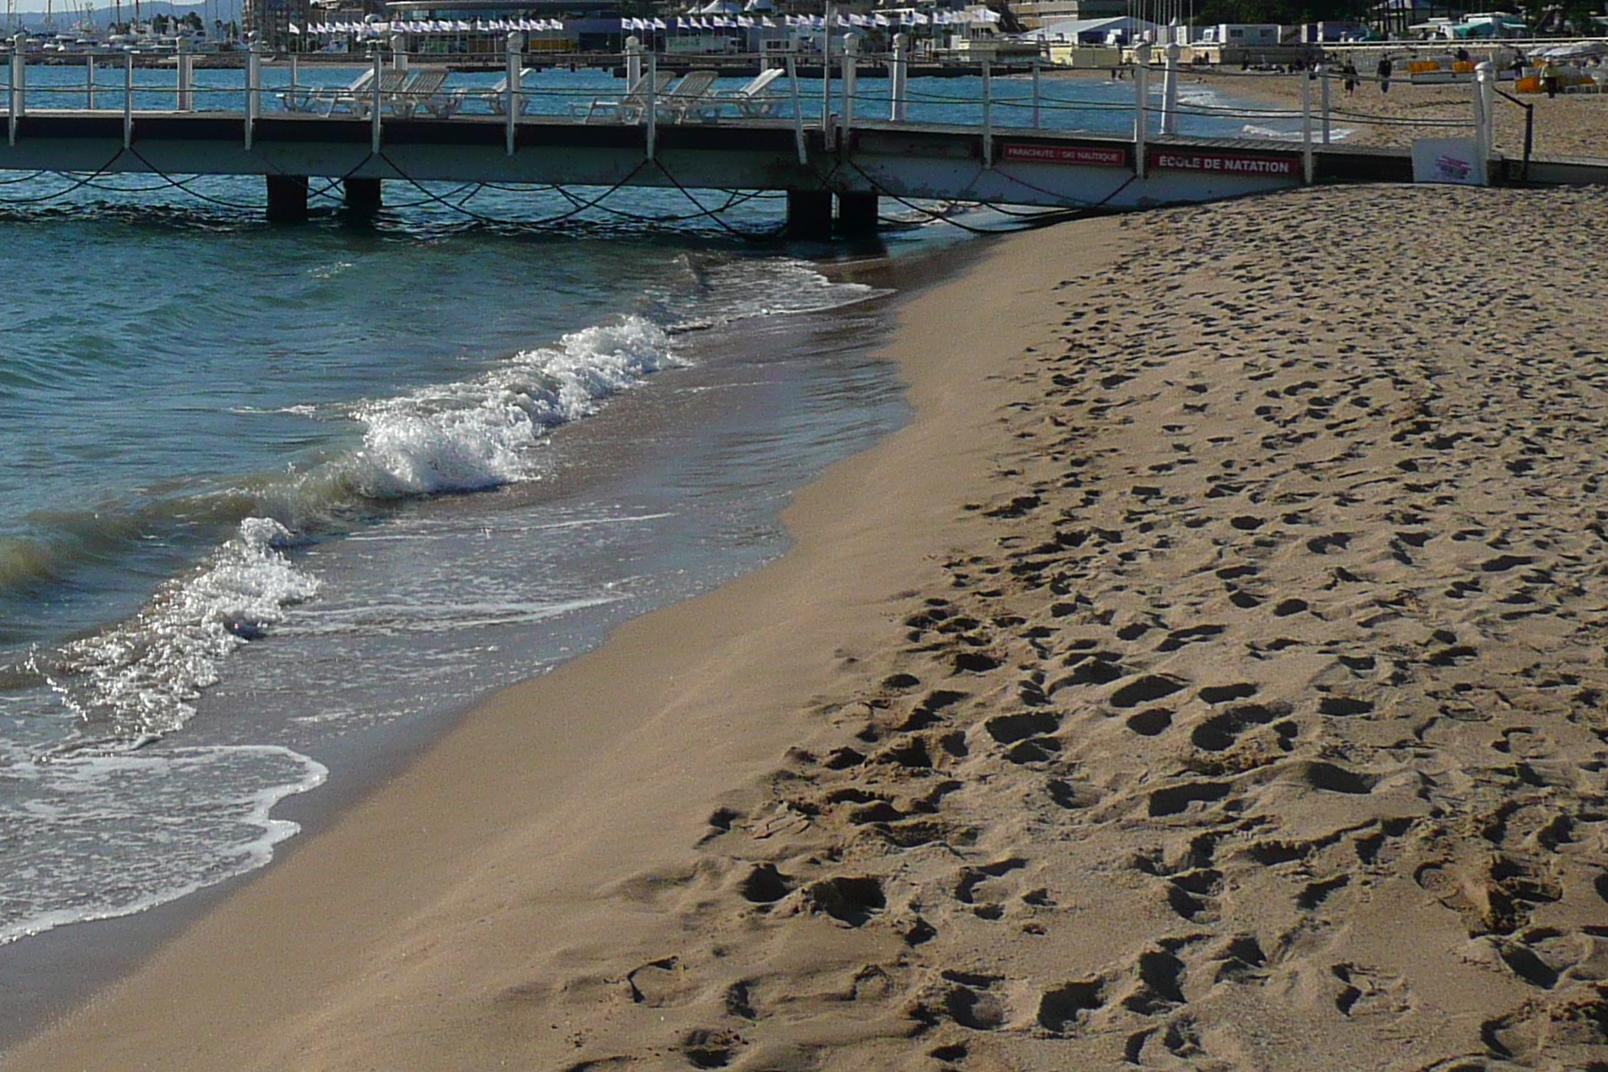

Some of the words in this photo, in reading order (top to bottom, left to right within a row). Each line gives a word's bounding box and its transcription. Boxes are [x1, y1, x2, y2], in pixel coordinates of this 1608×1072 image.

[1008, 148, 1055, 158] PARACHUTE
[1062, 151, 1075, 159] SKI
[1077, 151, 1119, 161] NAUTIQUE
[1159, 155, 1201, 168] ÉCOLE
[1203, 158, 1222, 170] DE
[1224, 160, 1289, 173] NATATION
